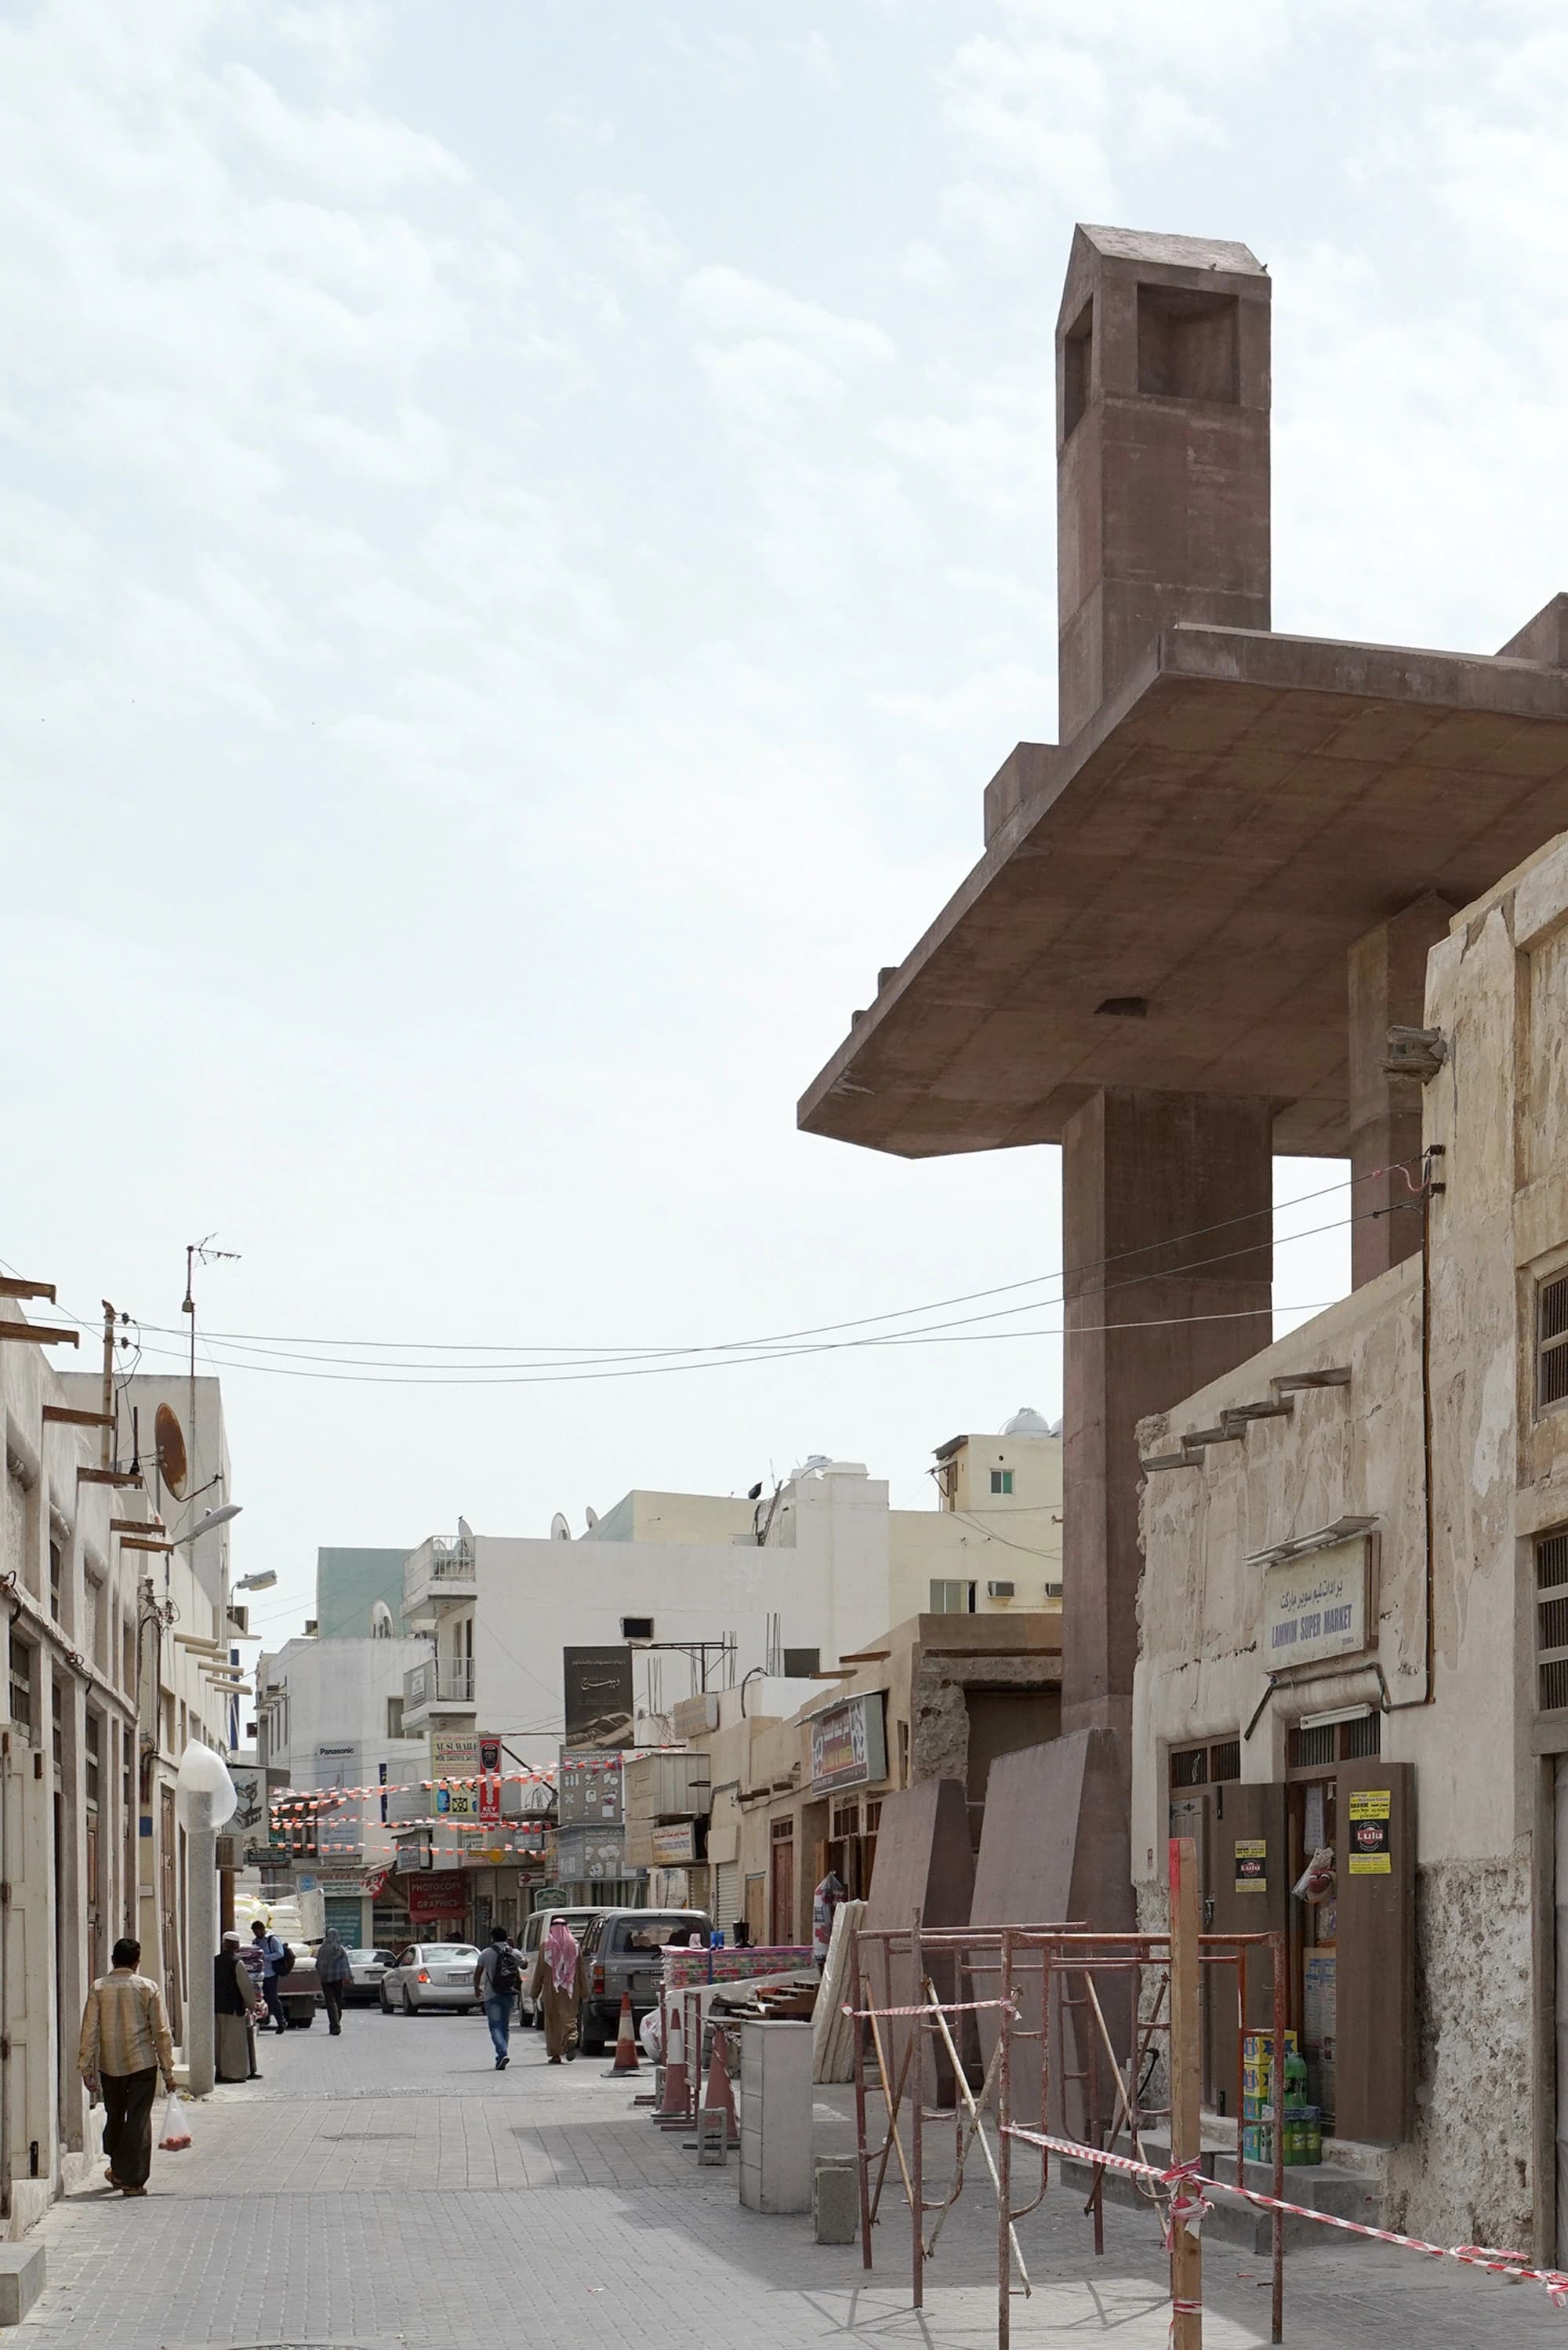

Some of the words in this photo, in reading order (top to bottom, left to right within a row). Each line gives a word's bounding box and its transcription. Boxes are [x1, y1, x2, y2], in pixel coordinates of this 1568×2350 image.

[1300, 1612, 1321, 1641] SUPER
[1323, 1604, 1352, 1635] MARKET
[320, 1747, 355, 1756] Panasonic
[1357, 1832, 1383, 1840] Lulu
[417, 1899, 458, 1909] GRAPHICS
